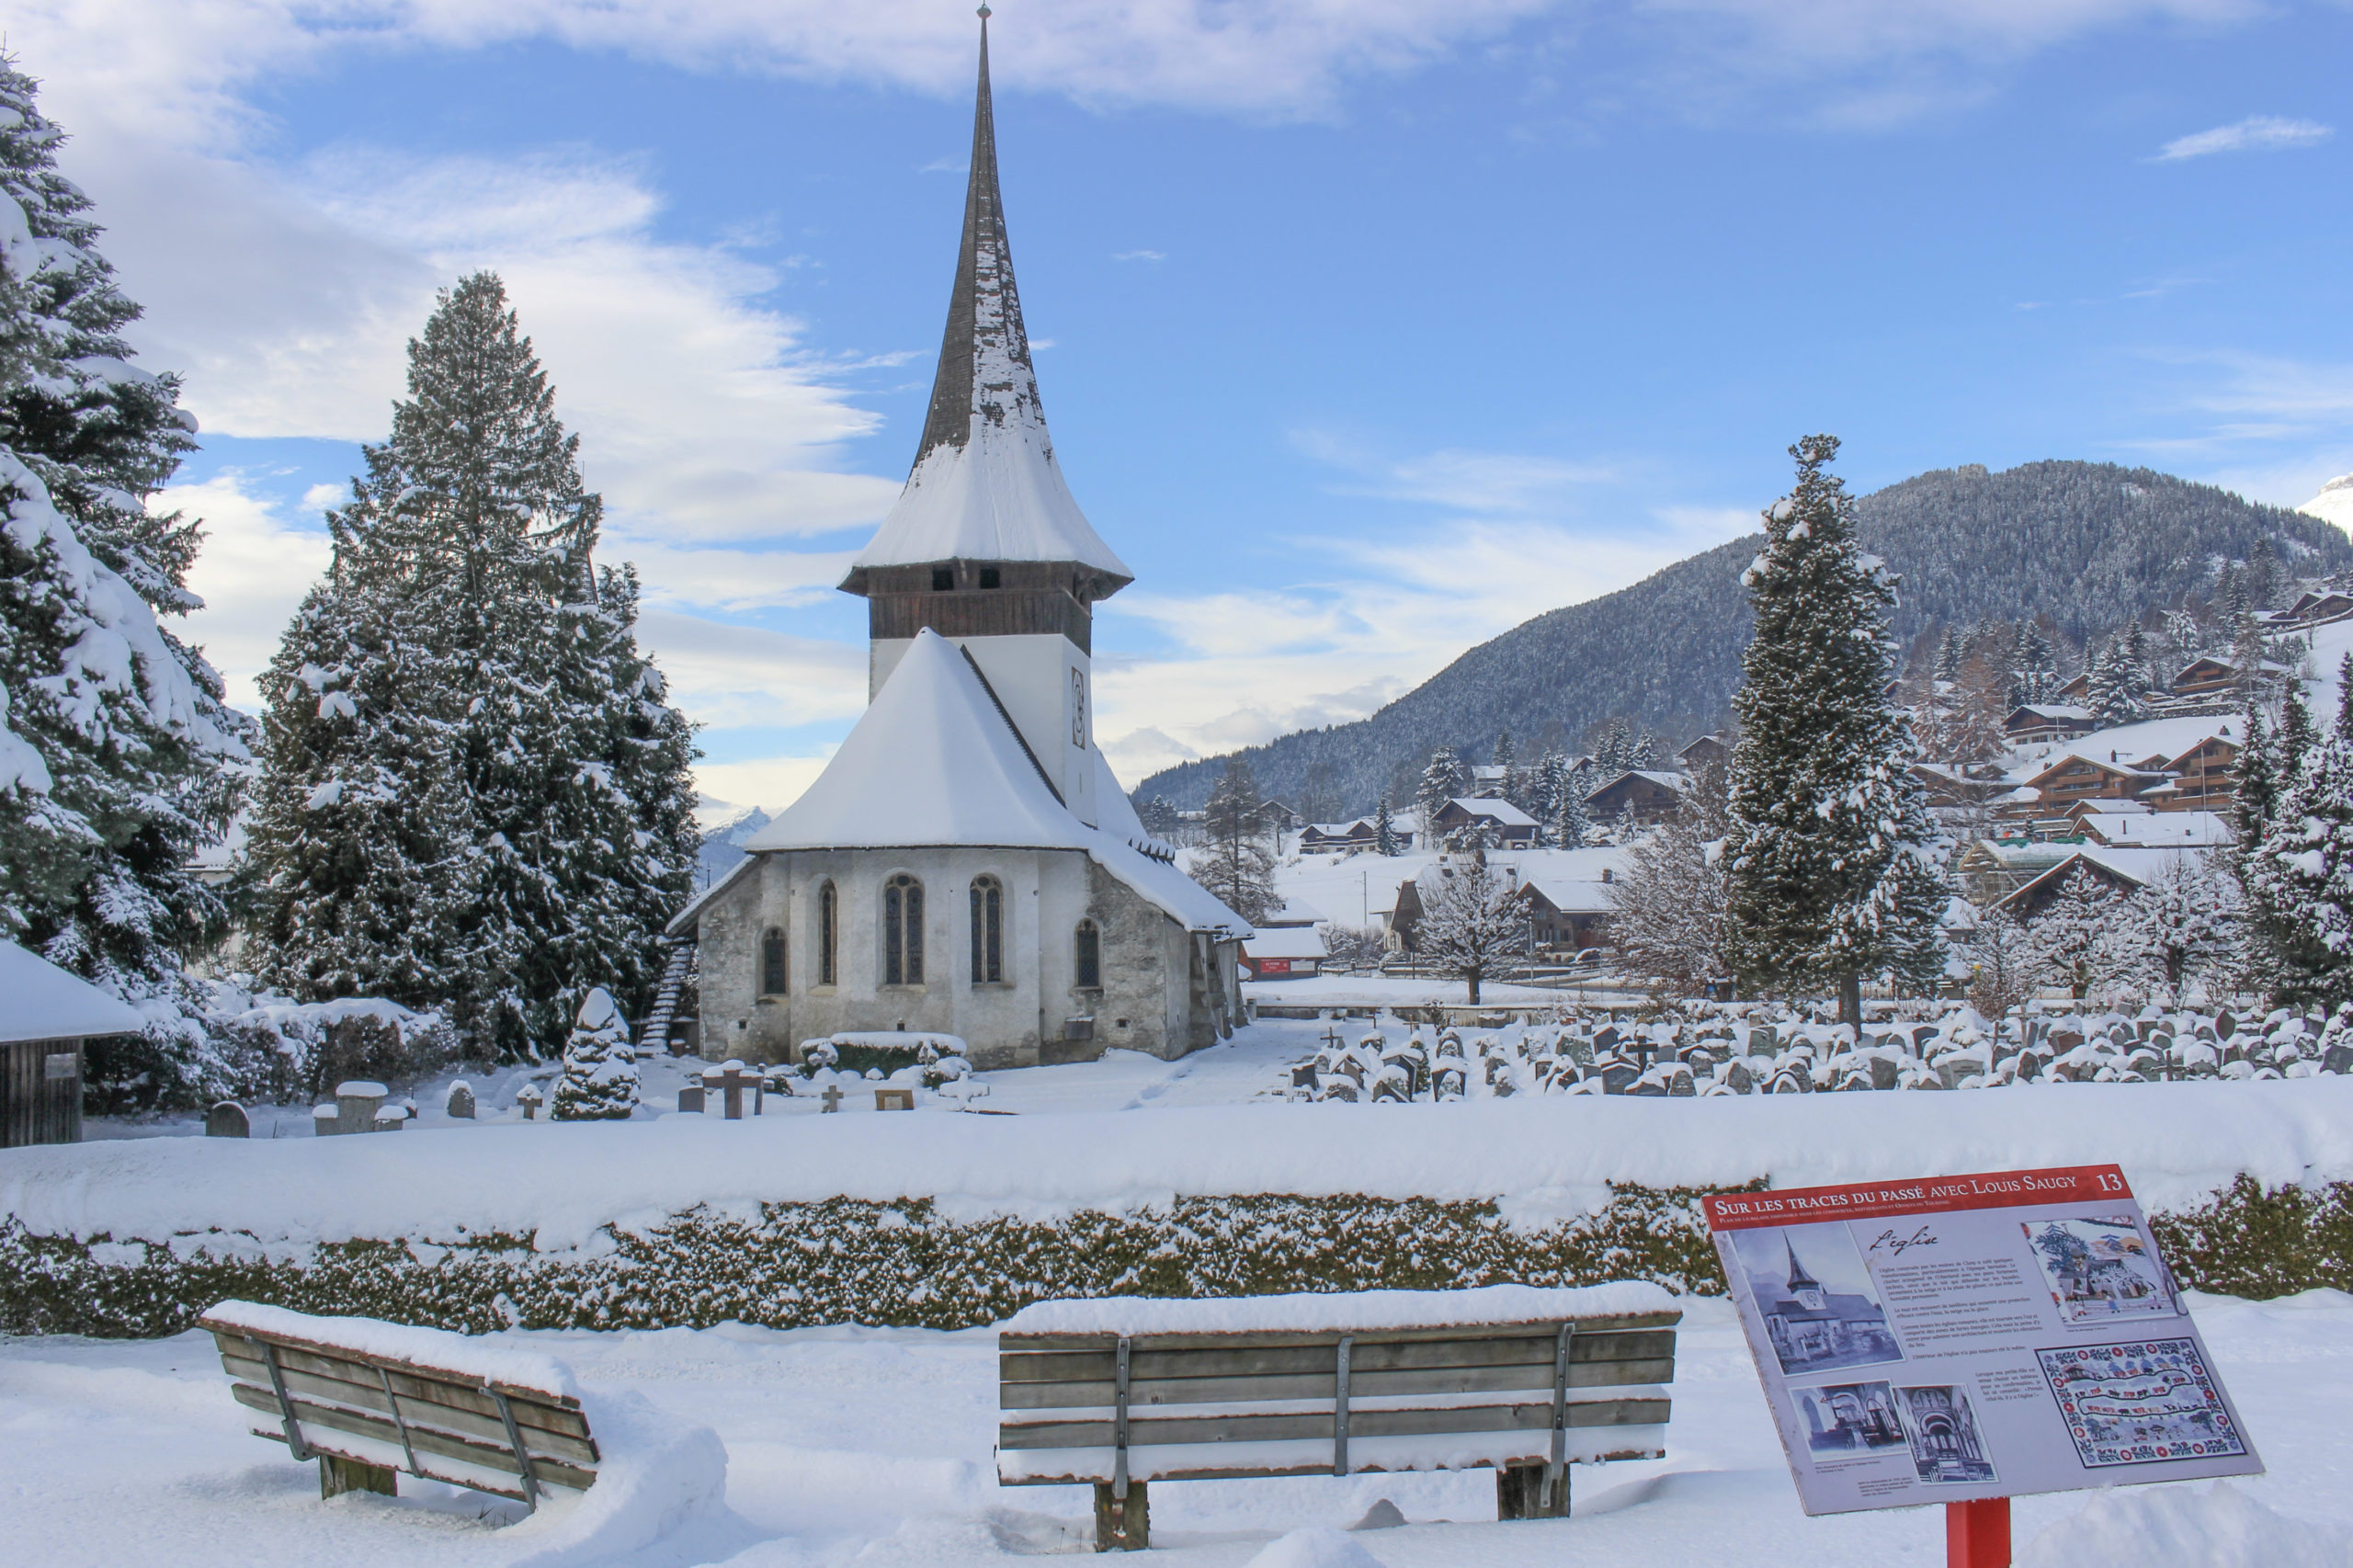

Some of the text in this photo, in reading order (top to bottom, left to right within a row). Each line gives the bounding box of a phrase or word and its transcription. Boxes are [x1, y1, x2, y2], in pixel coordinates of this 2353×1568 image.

[1714, 1176, 2075, 1215] SUR LES TRACES DU PASSÉ AVEC LOUIS SAUGY
[2097, 1174, 2122, 1191] 13
